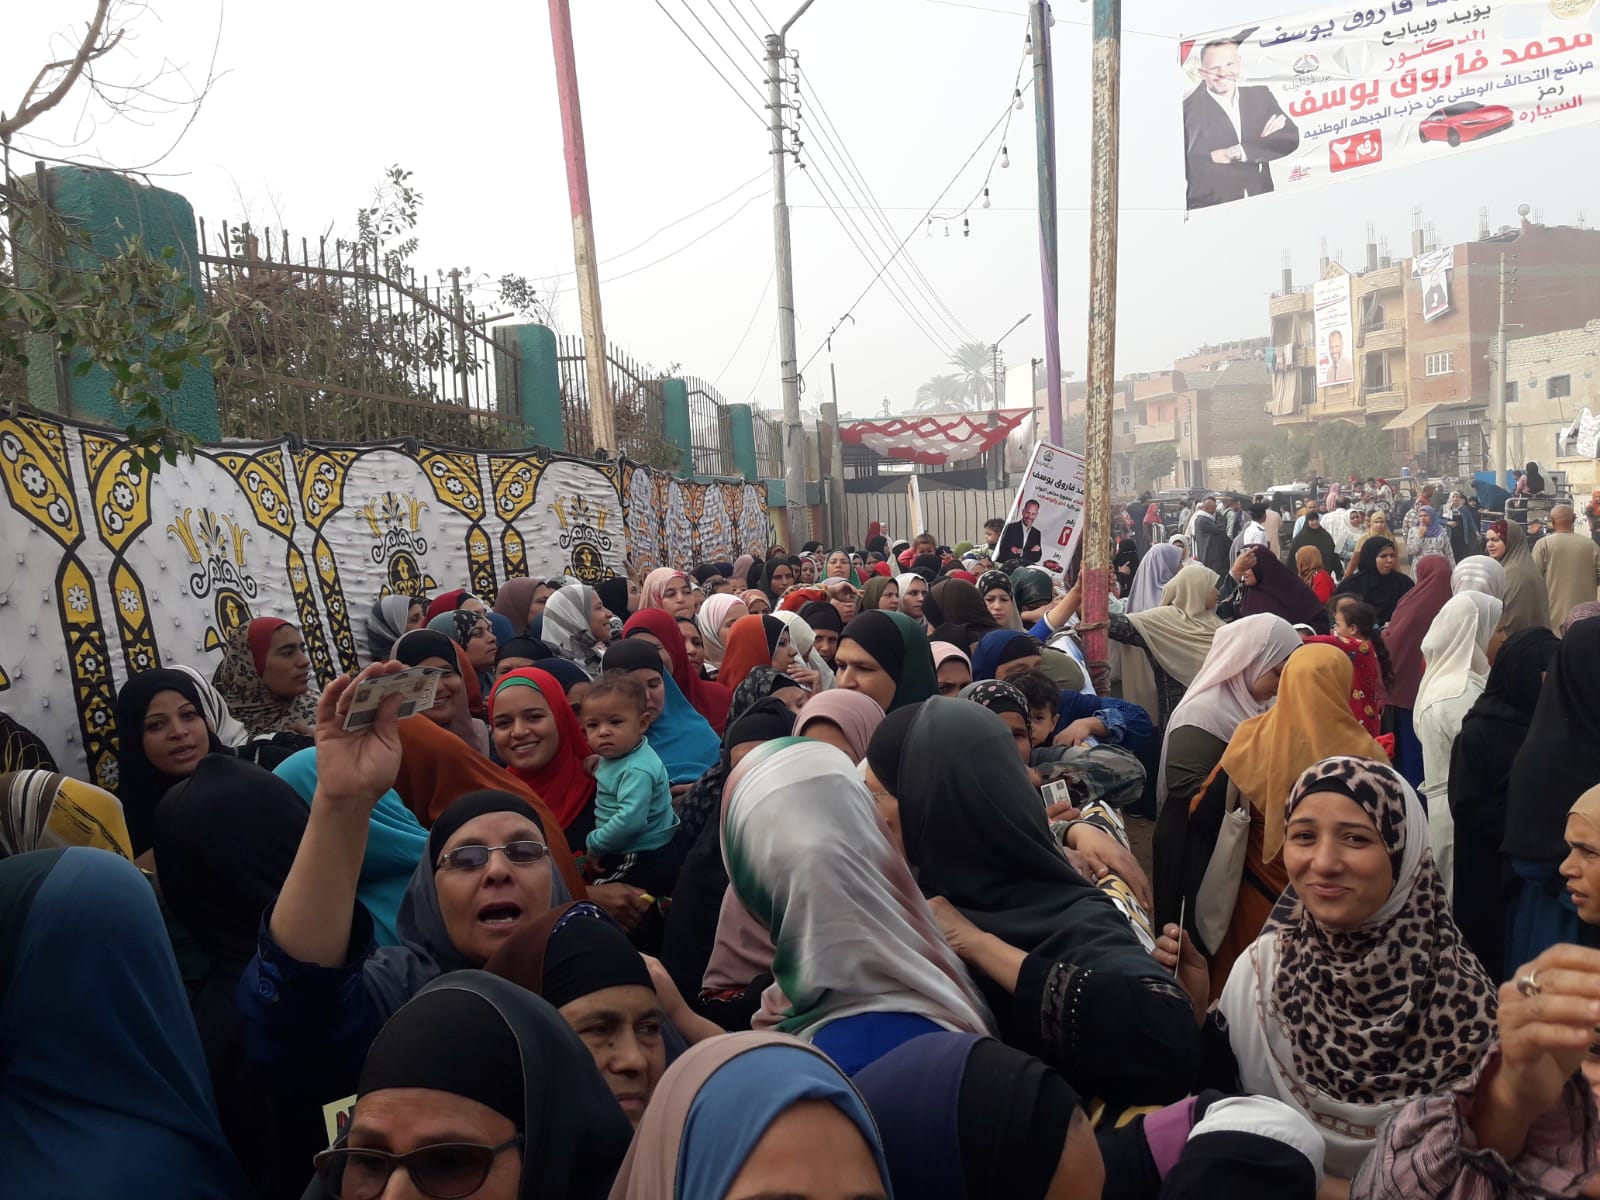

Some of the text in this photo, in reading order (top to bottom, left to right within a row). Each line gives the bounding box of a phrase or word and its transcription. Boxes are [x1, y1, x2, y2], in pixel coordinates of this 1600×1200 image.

[1259, 19, 1335, 48] يوسف
[1381, 16, 1438, 45] ويبايع
[1384, 28, 1486, 71] الدكتور
[1500, 33, 1593, 66] محمد
[1390, 49, 1489, 99] فاروق
[1496, 67, 1549, 89] التحالف
[1552, 59, 1593, 80] مرشح
[1289, 79, 1379, 117] يوسف
[1426, 95, 1445, 109] عن
[1538, 84, 1564, 100] رمز
[1394, 100, 1423, 116] حزب
[1332, 134, 1379, 165] رقم ٢
